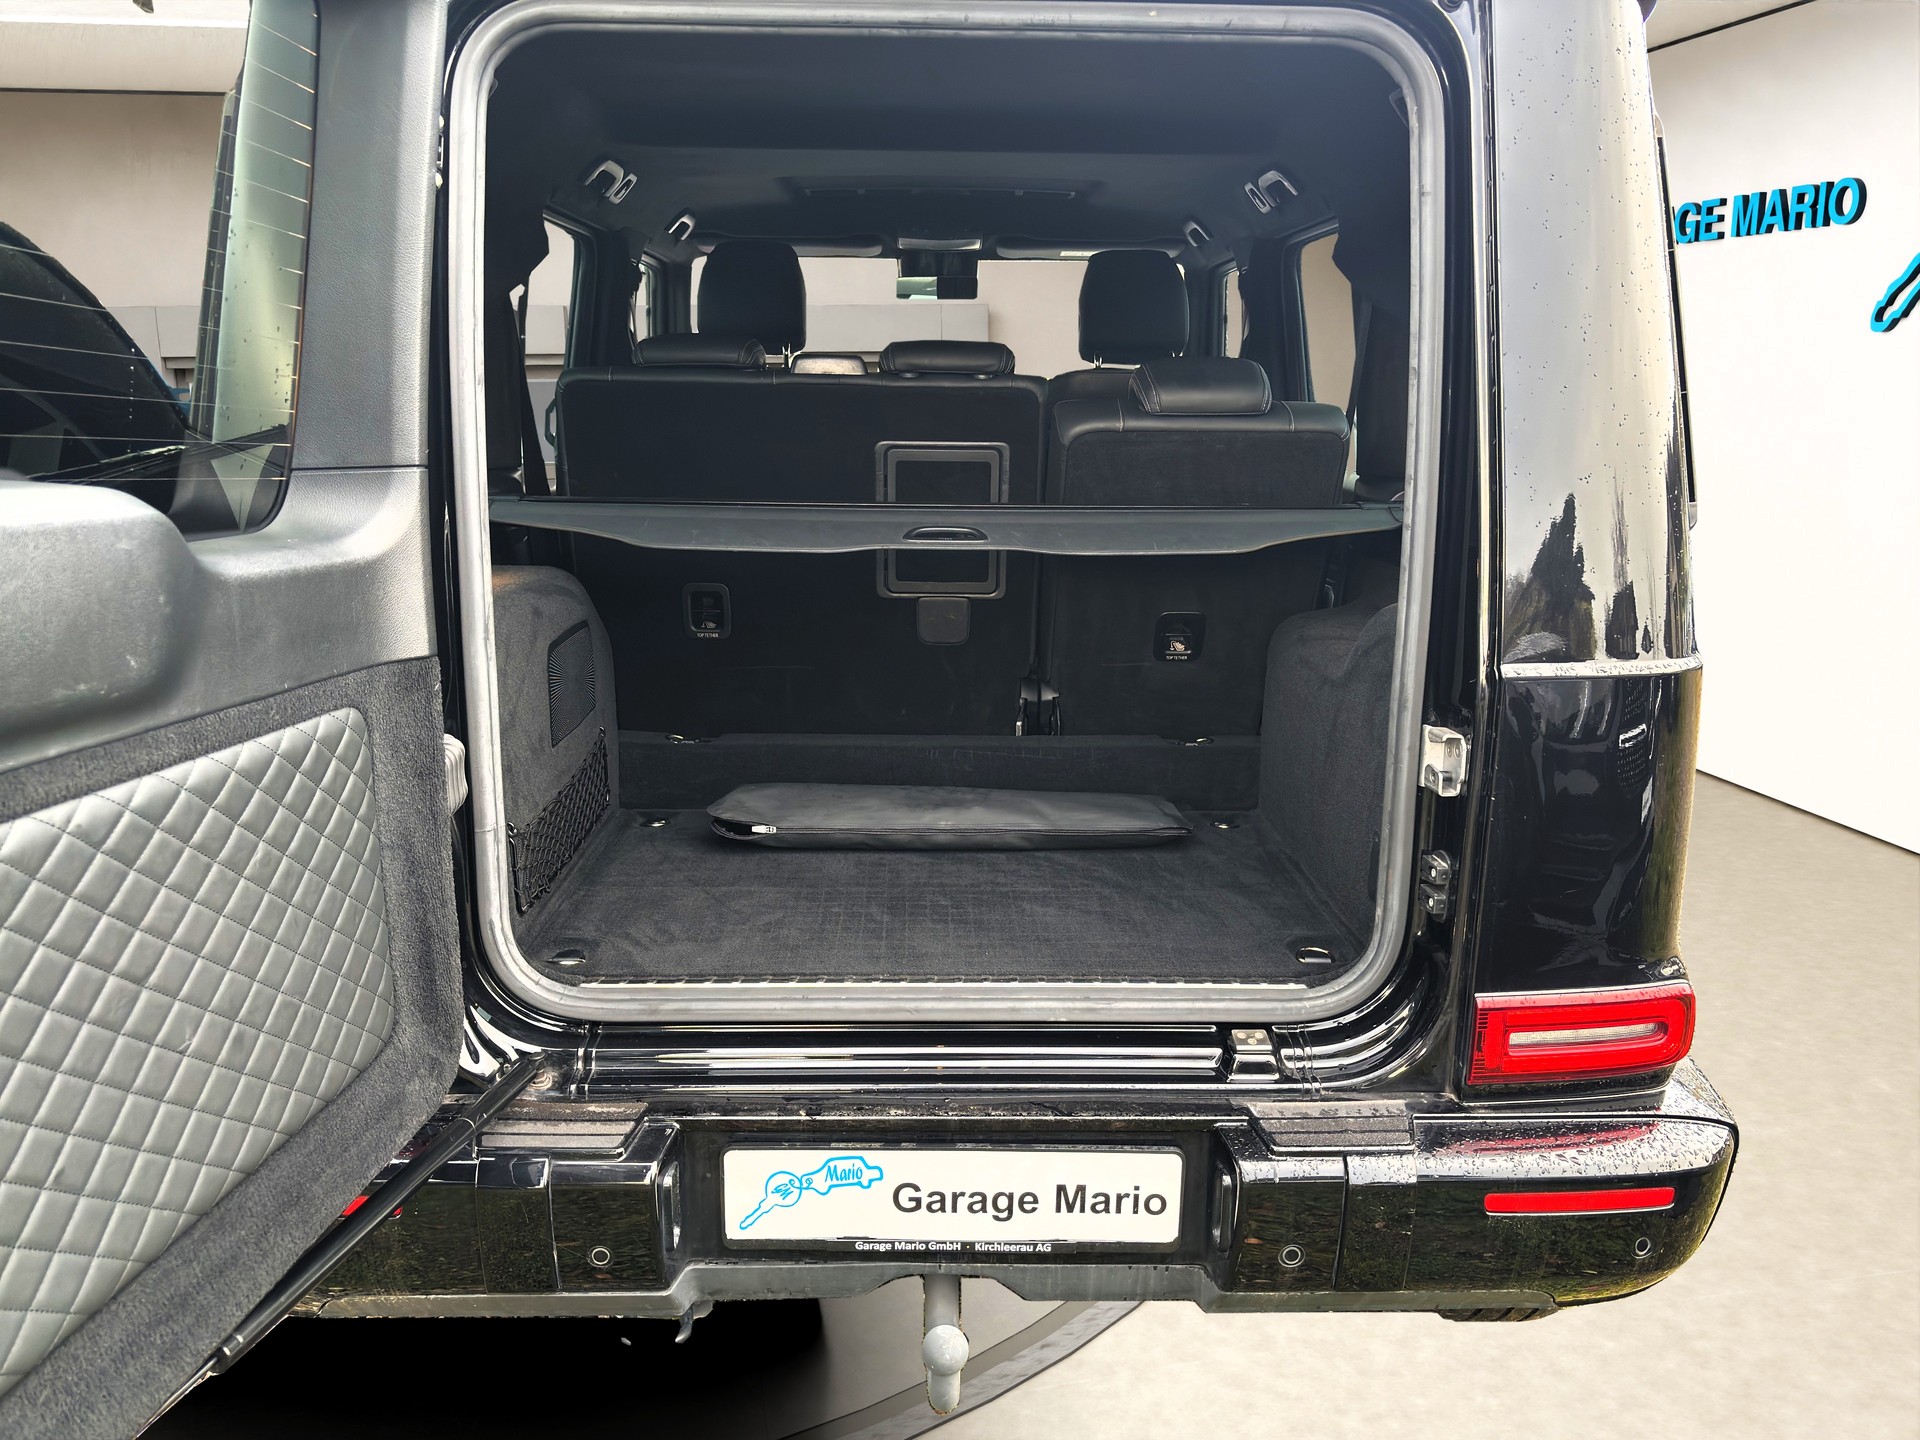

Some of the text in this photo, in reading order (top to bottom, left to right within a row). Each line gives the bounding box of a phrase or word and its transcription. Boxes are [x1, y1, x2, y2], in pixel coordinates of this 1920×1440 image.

[1672, 177, 1868, 246] GE MARIO
[824, 1163, 863, 1183] Mario
[892, 1182, 1167, 1222] Garage Mario
[855, 1241, 1052, 1252] Garage Mario GmbH Kirchleerau AG
